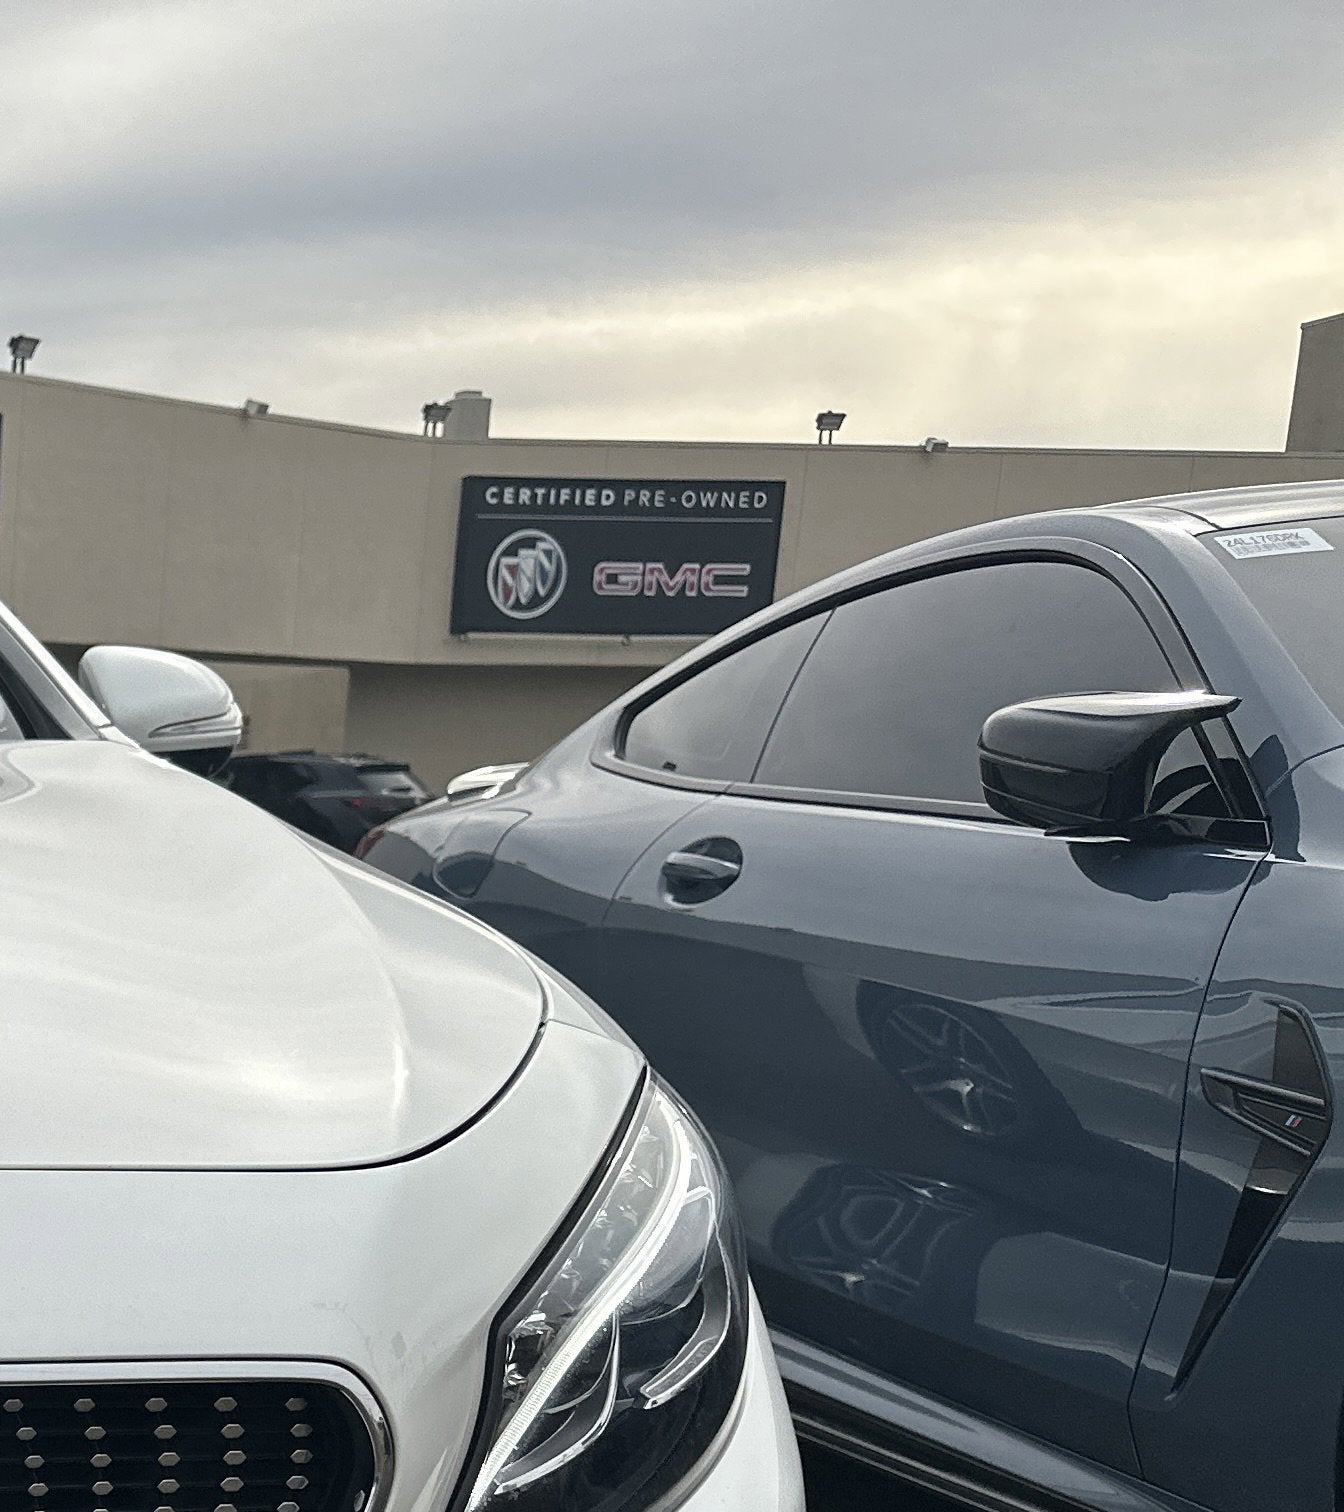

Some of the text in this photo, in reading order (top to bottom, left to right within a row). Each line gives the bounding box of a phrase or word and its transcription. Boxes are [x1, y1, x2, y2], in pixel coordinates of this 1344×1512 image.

[485, 486, 768, 509] CERTIFIED PRE-OWNED
[592, 561, 751, 597] GMC
